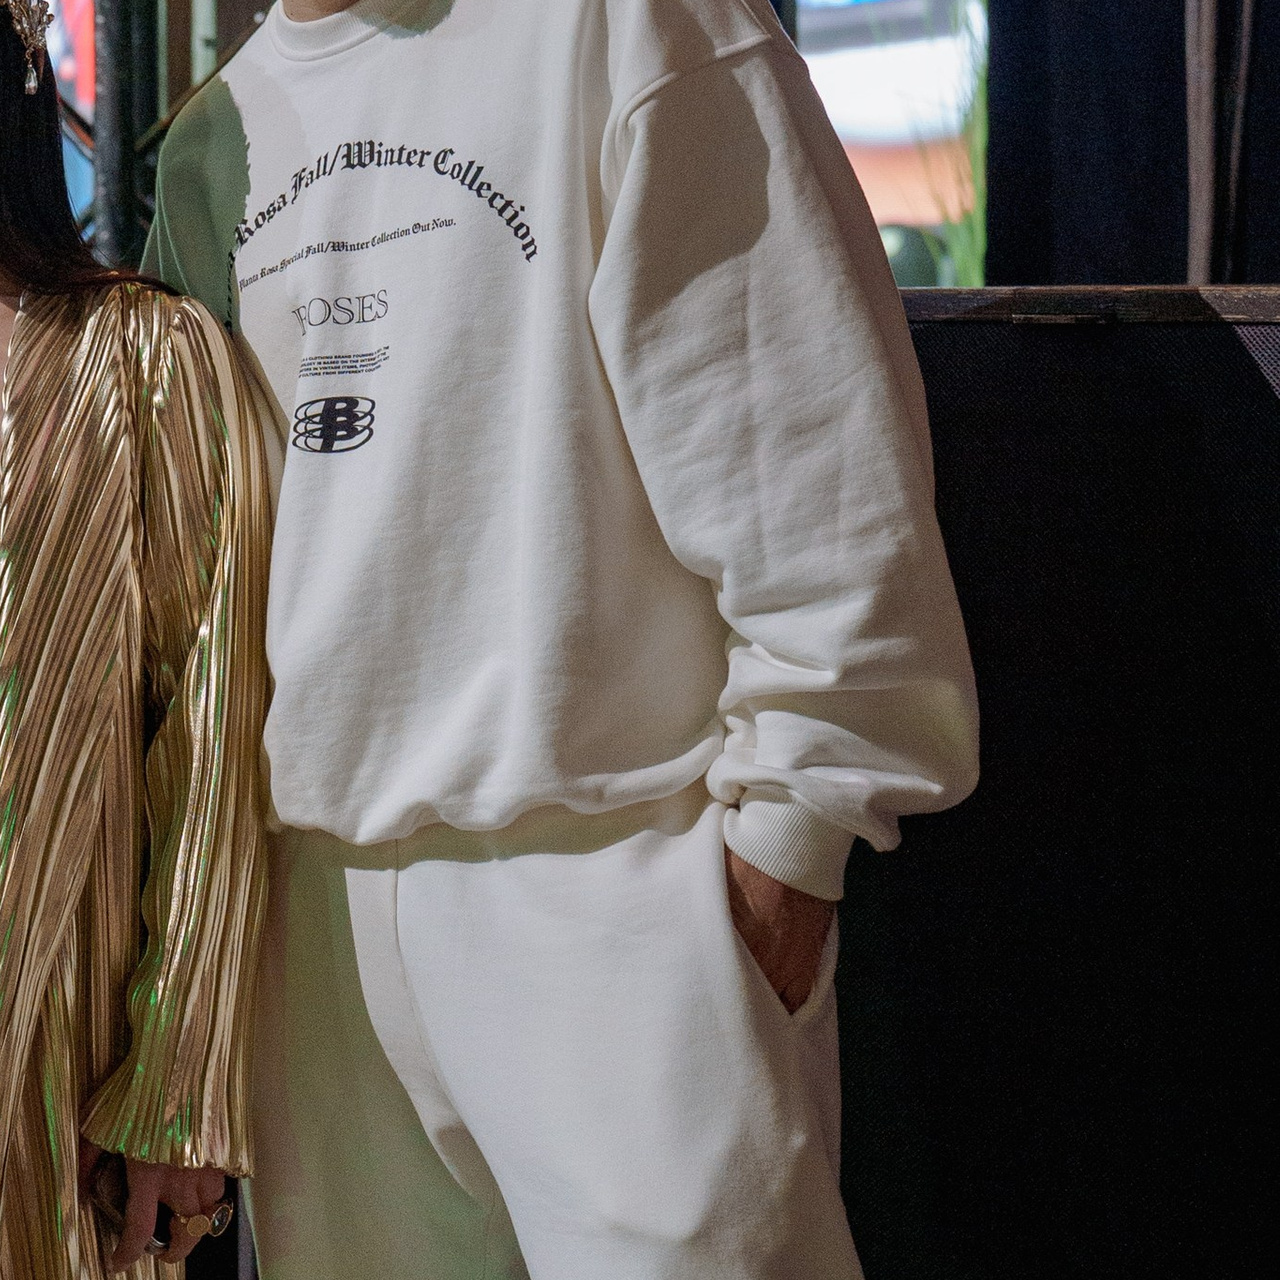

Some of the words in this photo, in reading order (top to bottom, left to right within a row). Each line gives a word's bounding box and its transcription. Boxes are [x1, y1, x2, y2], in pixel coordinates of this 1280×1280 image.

[234, 192, 288, 251] Rosa
[291, 139, 432, 204] Fall/Winter
[433, 147, 539, 263] Collection
[305, 240, 370, 259] Fall/Winter
[370, 227, 411, 247] Collection
[412, 222, 430, 234] Out
[431, 218, 456, 231] Now.
